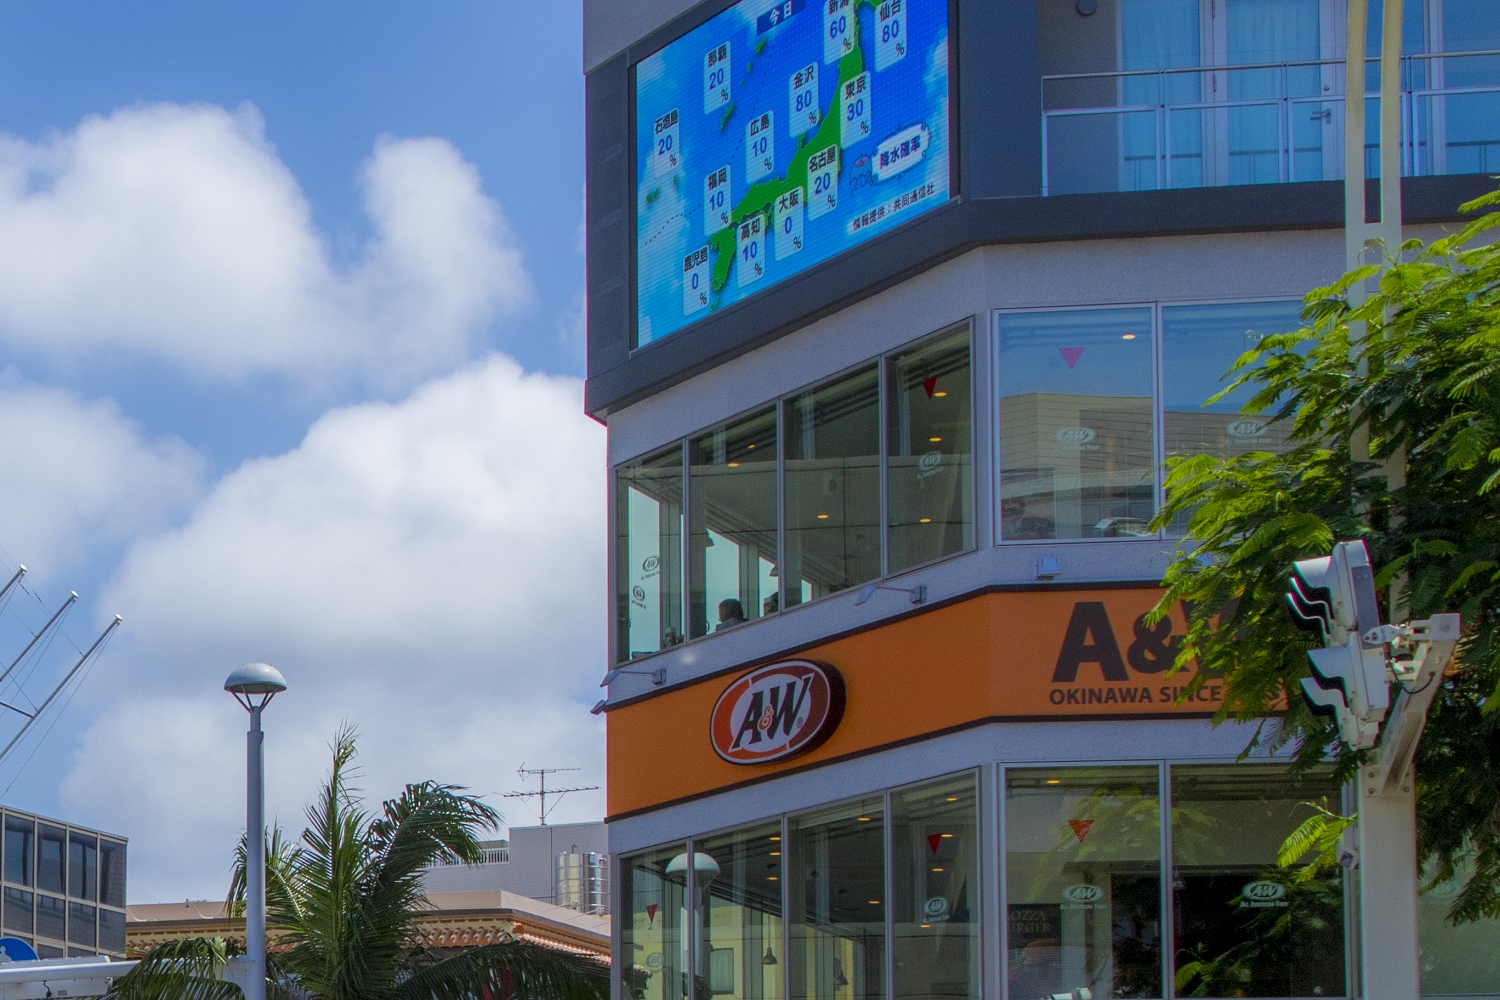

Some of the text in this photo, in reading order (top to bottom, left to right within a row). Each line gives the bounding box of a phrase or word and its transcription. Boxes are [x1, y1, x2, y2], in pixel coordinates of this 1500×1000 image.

[769, 4, 793, 25] 今日
[879, 0, 901, 21] 仙台
[830, 16, 846, 39] 60
[882, 20, 899, 43] 80
[708, 45, 726, 68] 那覇
[709, 69, 724, 91] 20
[793, 65, 814, 90] 金沢
[845, 75, 866, 100] 東京
[796, 90, 812, 113] 80
[847, 99, 863, 122] 30
[654, 110, 678, 135] 石垣島
[750, 112, 770, 136] 広島
[659, 135, 672, 156] 20
[752, 137, 767, 158] 10
[880, 135, 921, 169] 降水確率
[809, 147, 836, 173] 名古屋
[707, 169, 727, 191] 福岡
[814, 172, 830, 195] 20
[710, 191, 724, 211] 10
[778, 189, 799, 213] 大阪
[741, 218, 760, 242] 高知
[784, 216, 792, 234] 0
[742, 242, 757, 262] 10
[691, 273, 699, 290] 0
[1049, 685, 1222, 706] OKINAWA SINCE
[731, 674, 815, 749] A&W
[1008, 910, 1046, 920] OZZA
[1008, 922, 1051, 933] URGER
